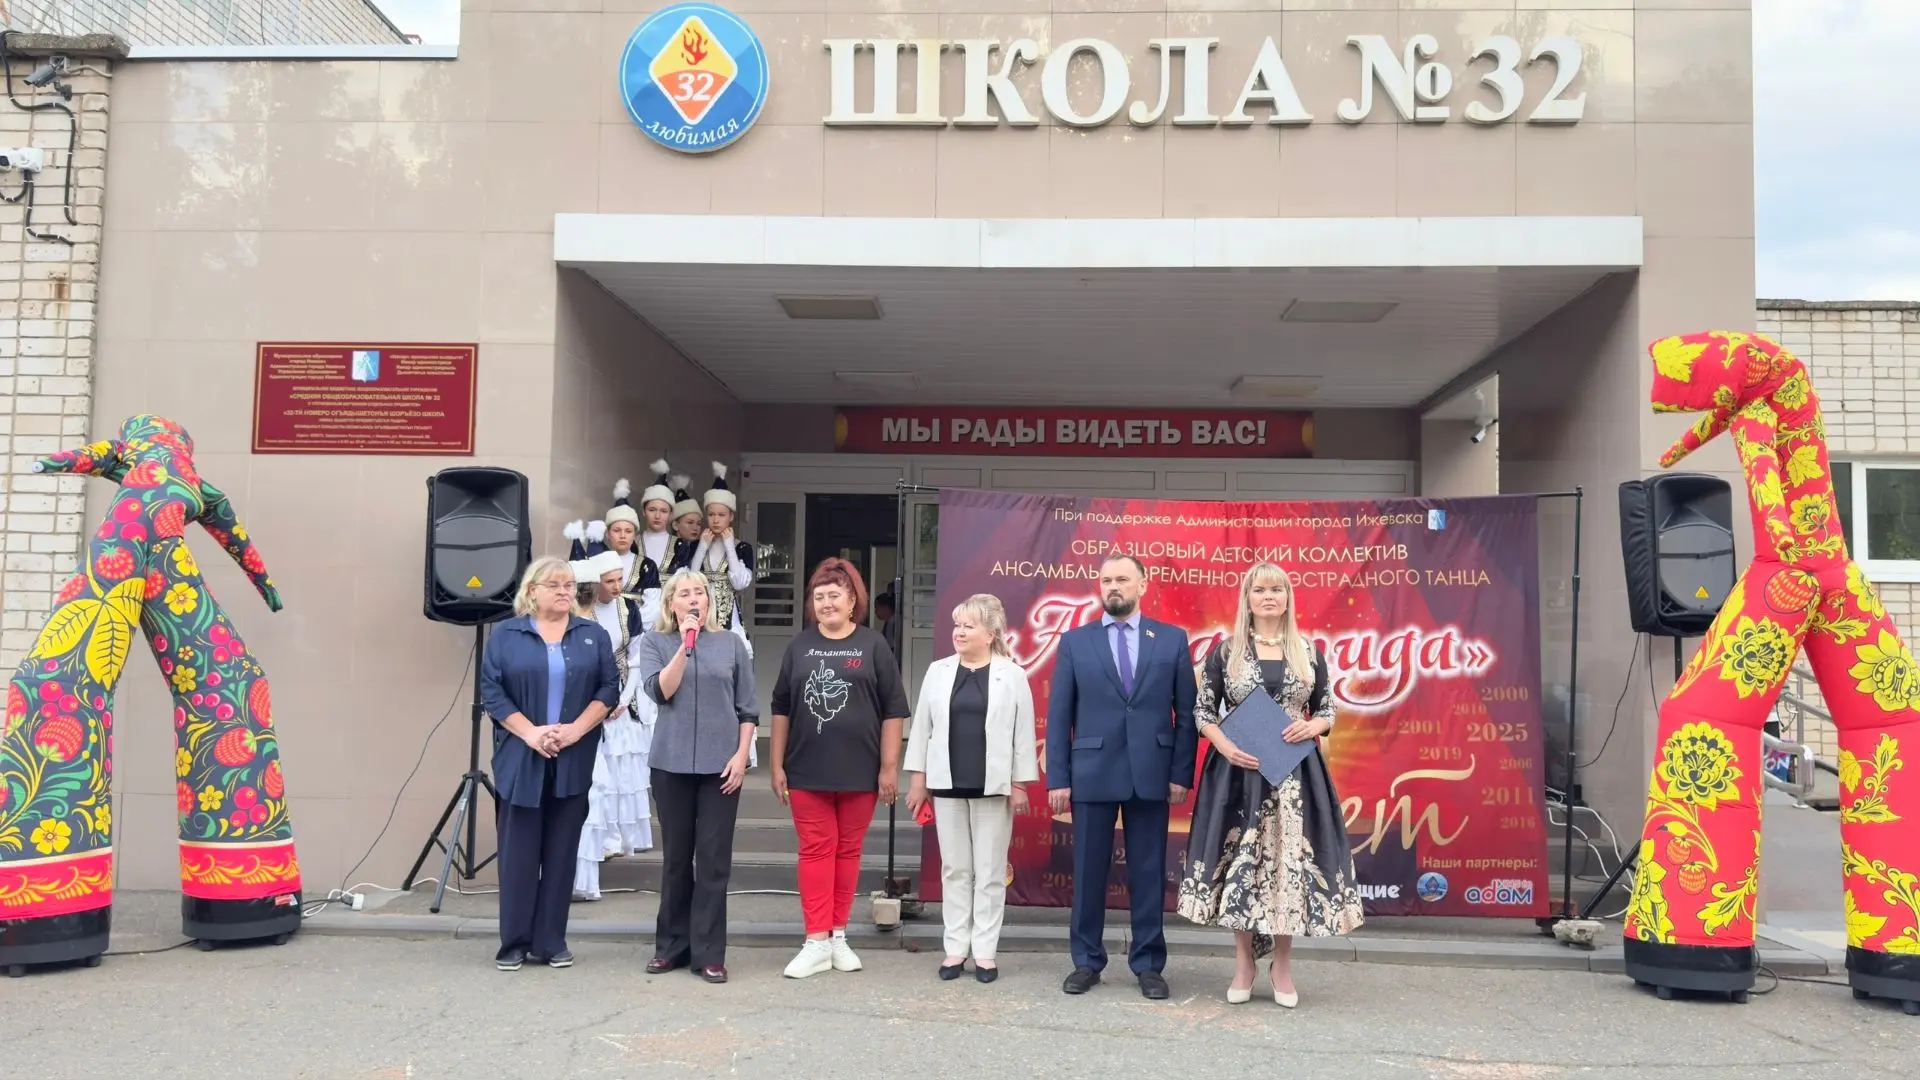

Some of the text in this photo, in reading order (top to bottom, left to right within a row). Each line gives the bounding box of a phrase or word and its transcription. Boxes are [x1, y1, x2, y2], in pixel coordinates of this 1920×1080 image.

[673, 72, 714, 102] 32
[822, 36, 1313, 127] ШКОЛА
[646, 118, 740, 145] любимая
[881, 417, 1267, 448] МЫ РАДЫ ВИДЕТЬ ВАС!
[1054, 508, 1423, 529] При поддержке Администрации города Ижевска
[1071, 540, 1409, 563] ОБРАЗЦОВЫЙ ДЕТСКИЙ КОЛЛЕКТИВ
[1425, 569, 1491, 587] ТАНЦА
[804, 648, 863, 657] Атлантида
[844, 658, 862, 668] 30
[1481, 686, 1529, 702] 2000
[1466, 722, 1529, 742] 2025
[1419, 746, 1462, 761] 2019
[1481, 785, 1535, 806] 2011
[1422, 857, 1538, 871] Наши партнеры:
